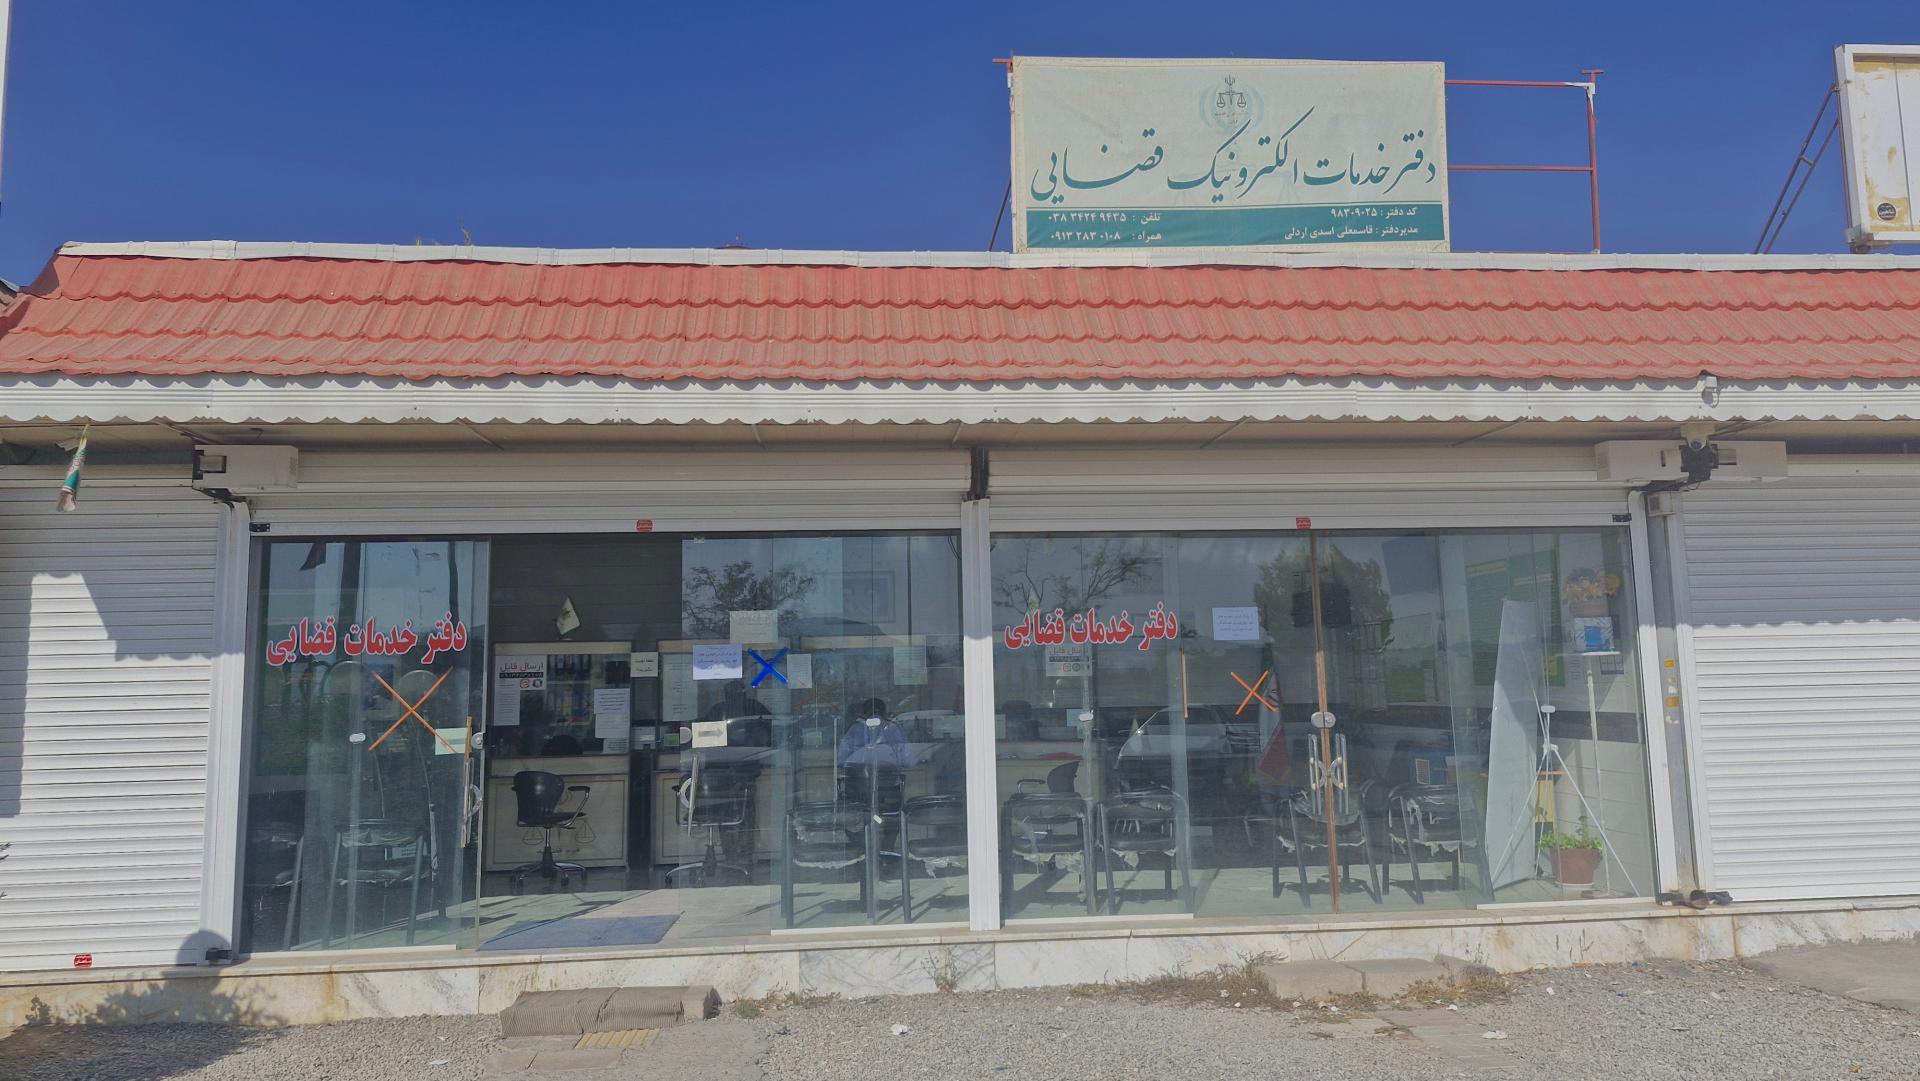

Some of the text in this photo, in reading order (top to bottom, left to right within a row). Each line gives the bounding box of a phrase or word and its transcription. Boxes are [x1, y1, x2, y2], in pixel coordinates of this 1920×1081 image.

[1030, 105, 1436, 204] دفتر خدمات الکترونیک قضایی
[1048, 212, 1067, 222] ۰۳۸
[1331, 208, 1378, 218] ۹۸۳۰۹۰۲۵
[1385, 207, 1404, 219] دفتر
[1406, 206, 1418, 216] کد
[1140, 212, 1161, 225] تلفن
[1051, 231, 1073, 241] ۰۹۱۳
[1076, 231, 1097, 241] ۲۸۳
[1100, 231, 1121, 241] ۰۱۰۸
[1137, 231, 1162, 244] همراه
[1284, 227, 1307, 240] اردلی
[1309, 226, 1334, 238] اسدی
[1004, 607, 1066, 650] قضایی
[1070, 607, 1134, 645] خدمات
[1138, 601, 1178, 651] دفتر
[266, 611, 467, 666] دفتر خدمات قضایی
